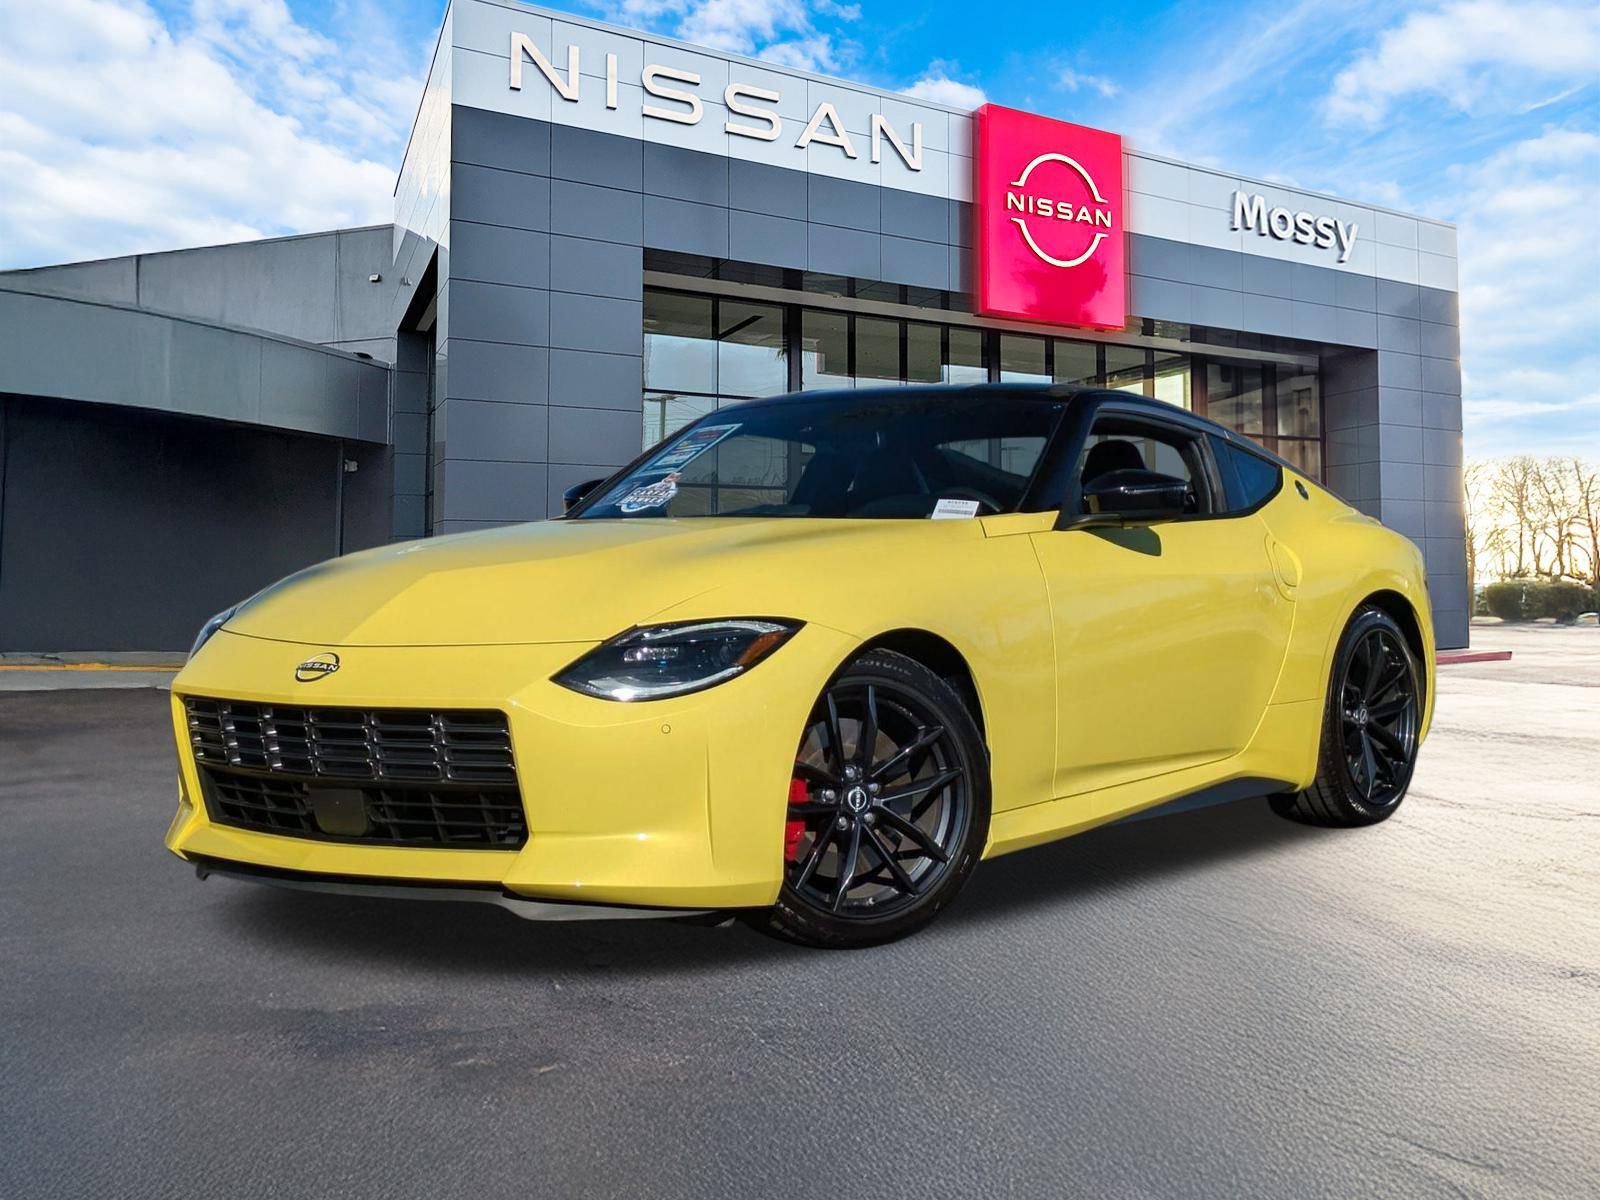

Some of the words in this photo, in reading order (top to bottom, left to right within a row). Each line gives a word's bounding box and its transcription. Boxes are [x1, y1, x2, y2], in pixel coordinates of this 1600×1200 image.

[509, 31, 922, 172] NISSAN
[1006, 191, 1112, 228] NISSAN
[1230, 189, 1359, 262] Mossy
